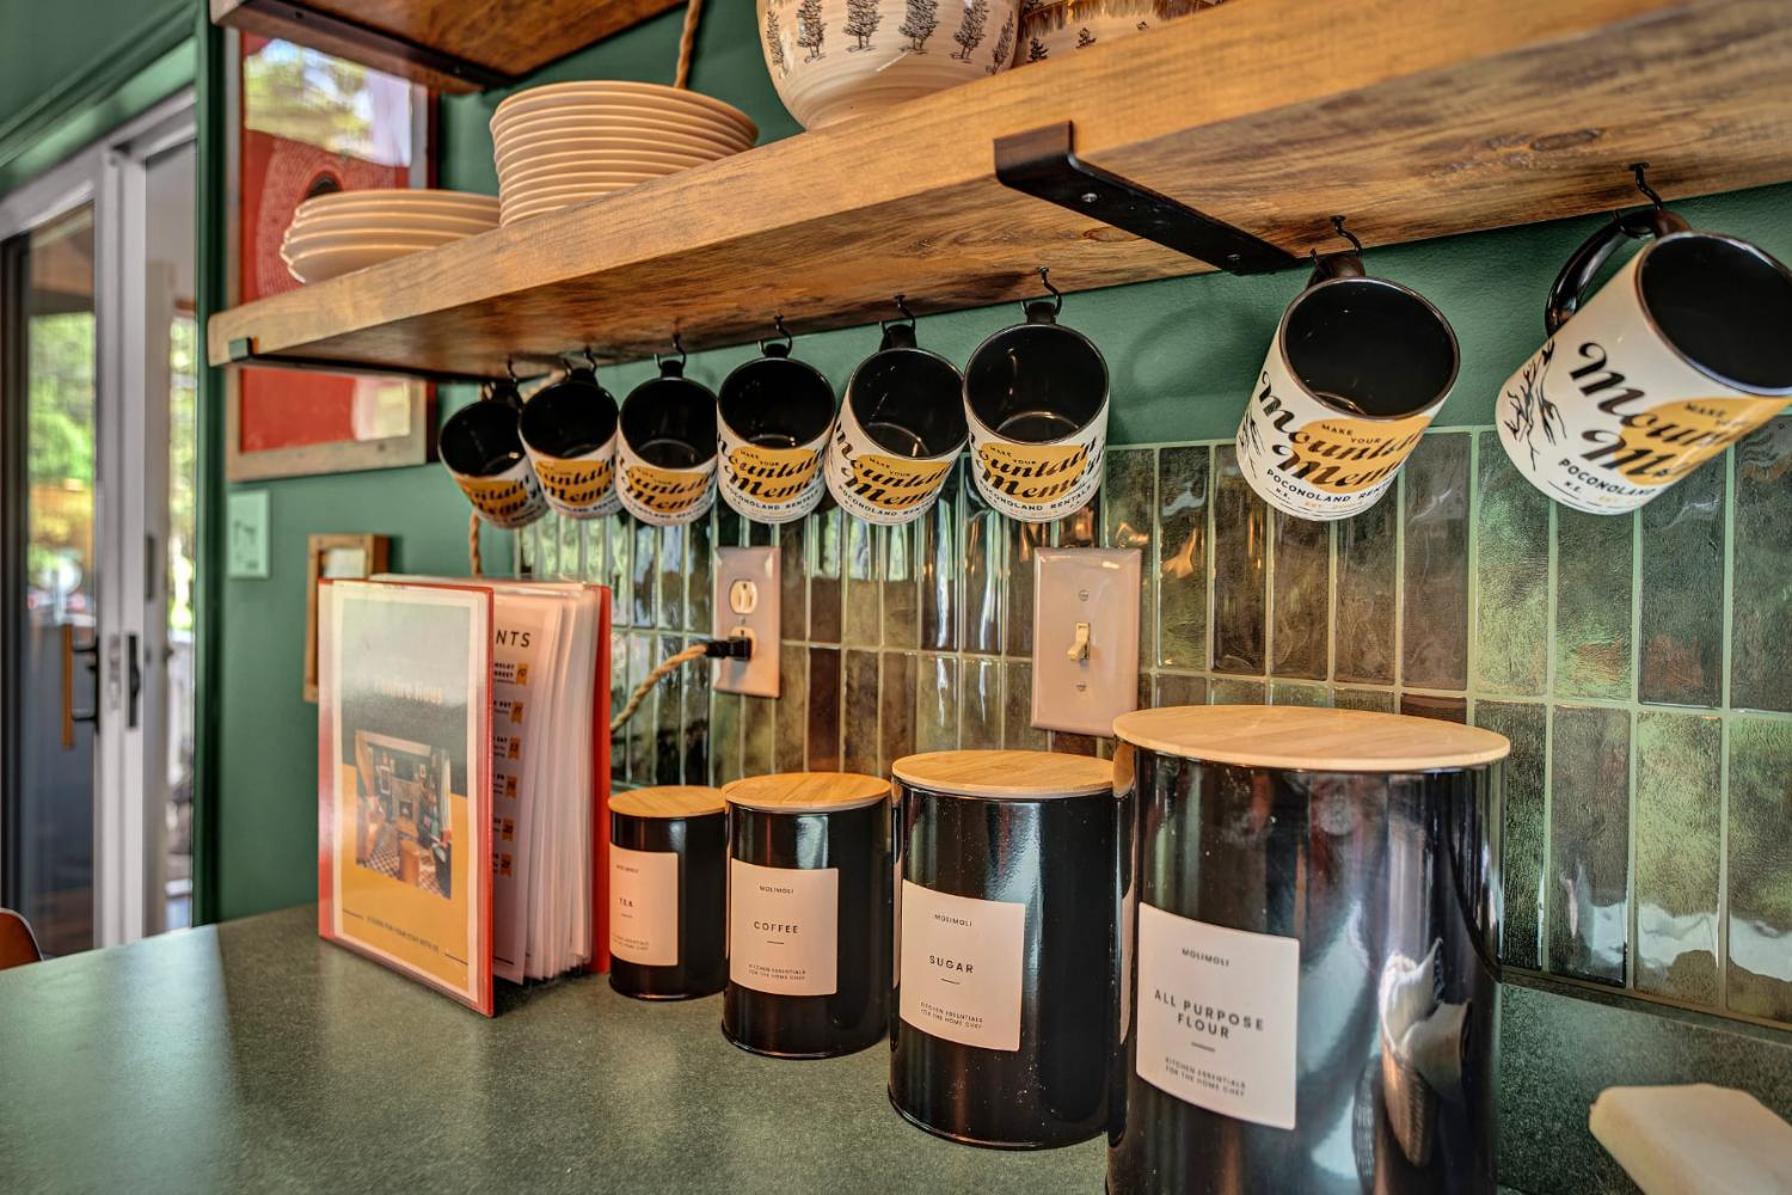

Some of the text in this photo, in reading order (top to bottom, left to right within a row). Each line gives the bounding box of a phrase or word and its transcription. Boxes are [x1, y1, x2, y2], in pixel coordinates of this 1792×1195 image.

[1320, 423, 1354, 436] MAKE
[1266, 468, 1351, 503] POCONOLAND
[619, 897, 634, 907] TEA
[753, 920, 799, 934] COFFEE
[929, 954, 974, 974] SUGAR
[1181, 948, 1230, 967] MOLIMOLI
[1154, 989, 1265, 1031] ALL PURPOSE
[1177, 1012, 1230, 1039] FLOUR
[1165, 1056, 1246, 1089] KITCHEN ESSENTIALS
[1165, 1065, 1245, 1097] FOR THE HOME CHEF
